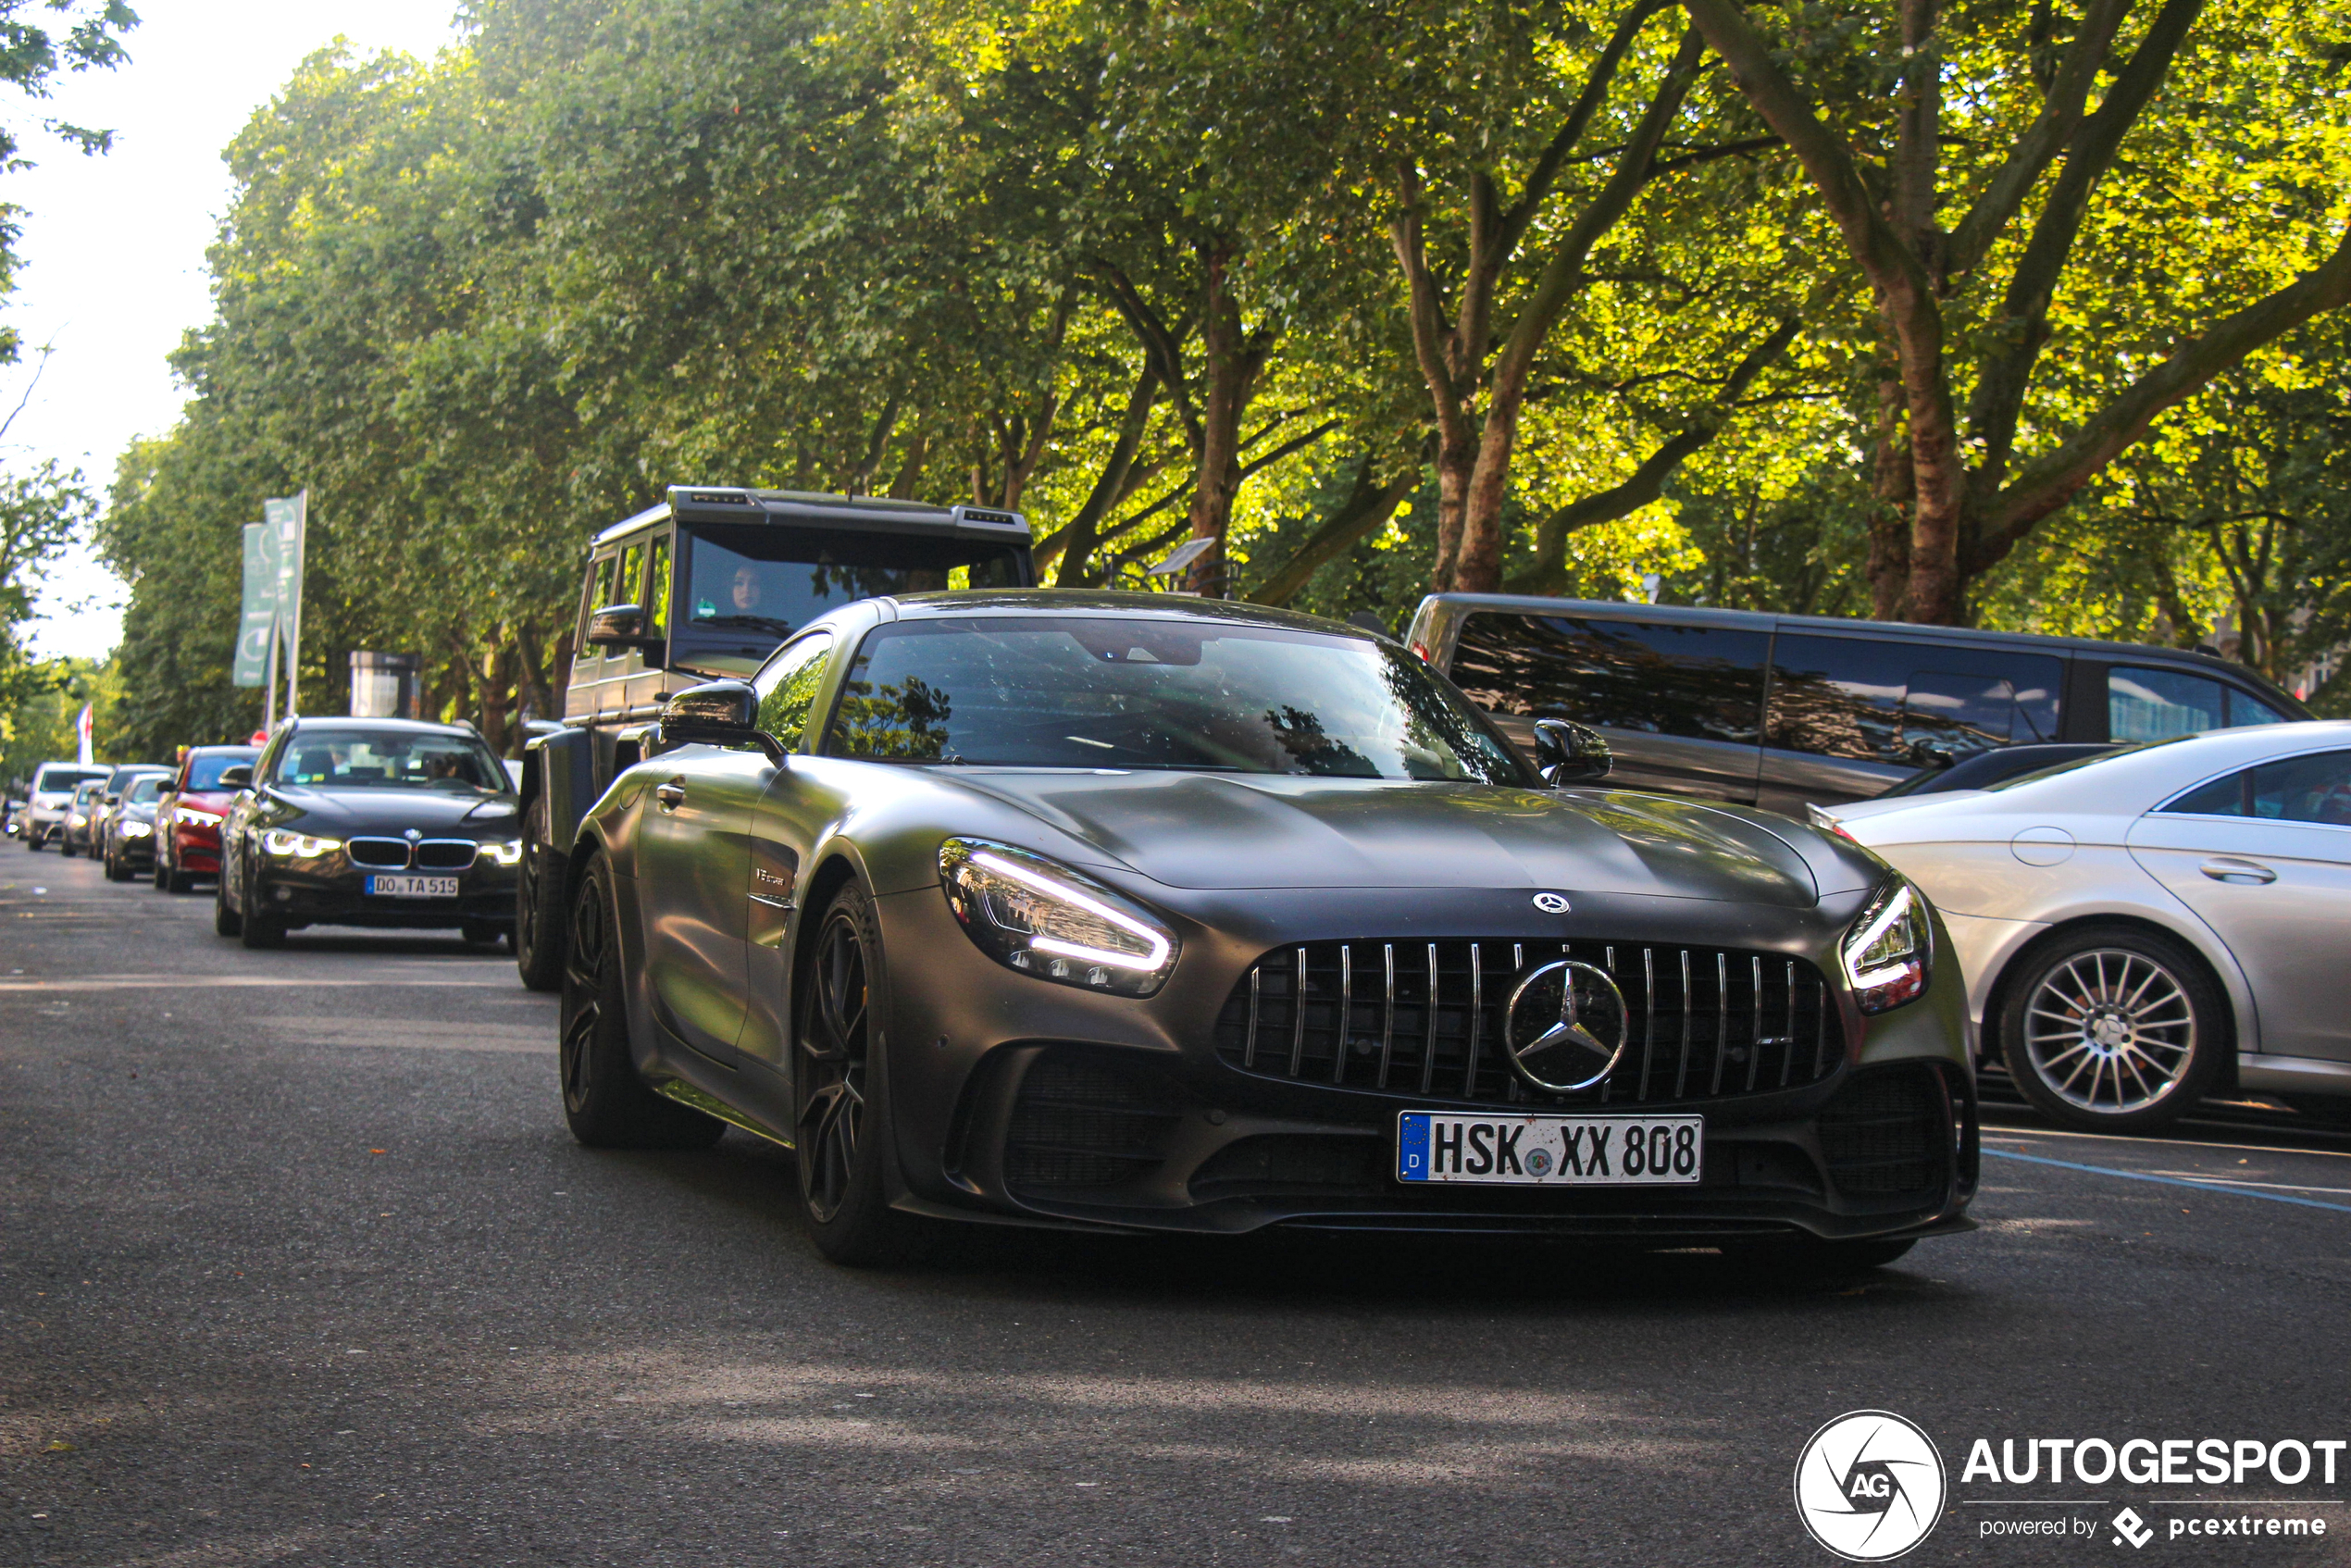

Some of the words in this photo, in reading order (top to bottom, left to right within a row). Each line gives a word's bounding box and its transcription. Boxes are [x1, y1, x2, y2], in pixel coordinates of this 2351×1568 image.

[376, 877, 396, 892] DO
[406, 878, 425, 893] TA
[429, 879, 456, 894] 515
[1434, 1123, 1524, 1176] HSK
[1558, 1126, 1611, 1176] XX
[1623, 1125, 1696, 1176] 808
[1409, 1154, 1419, 1168] D
